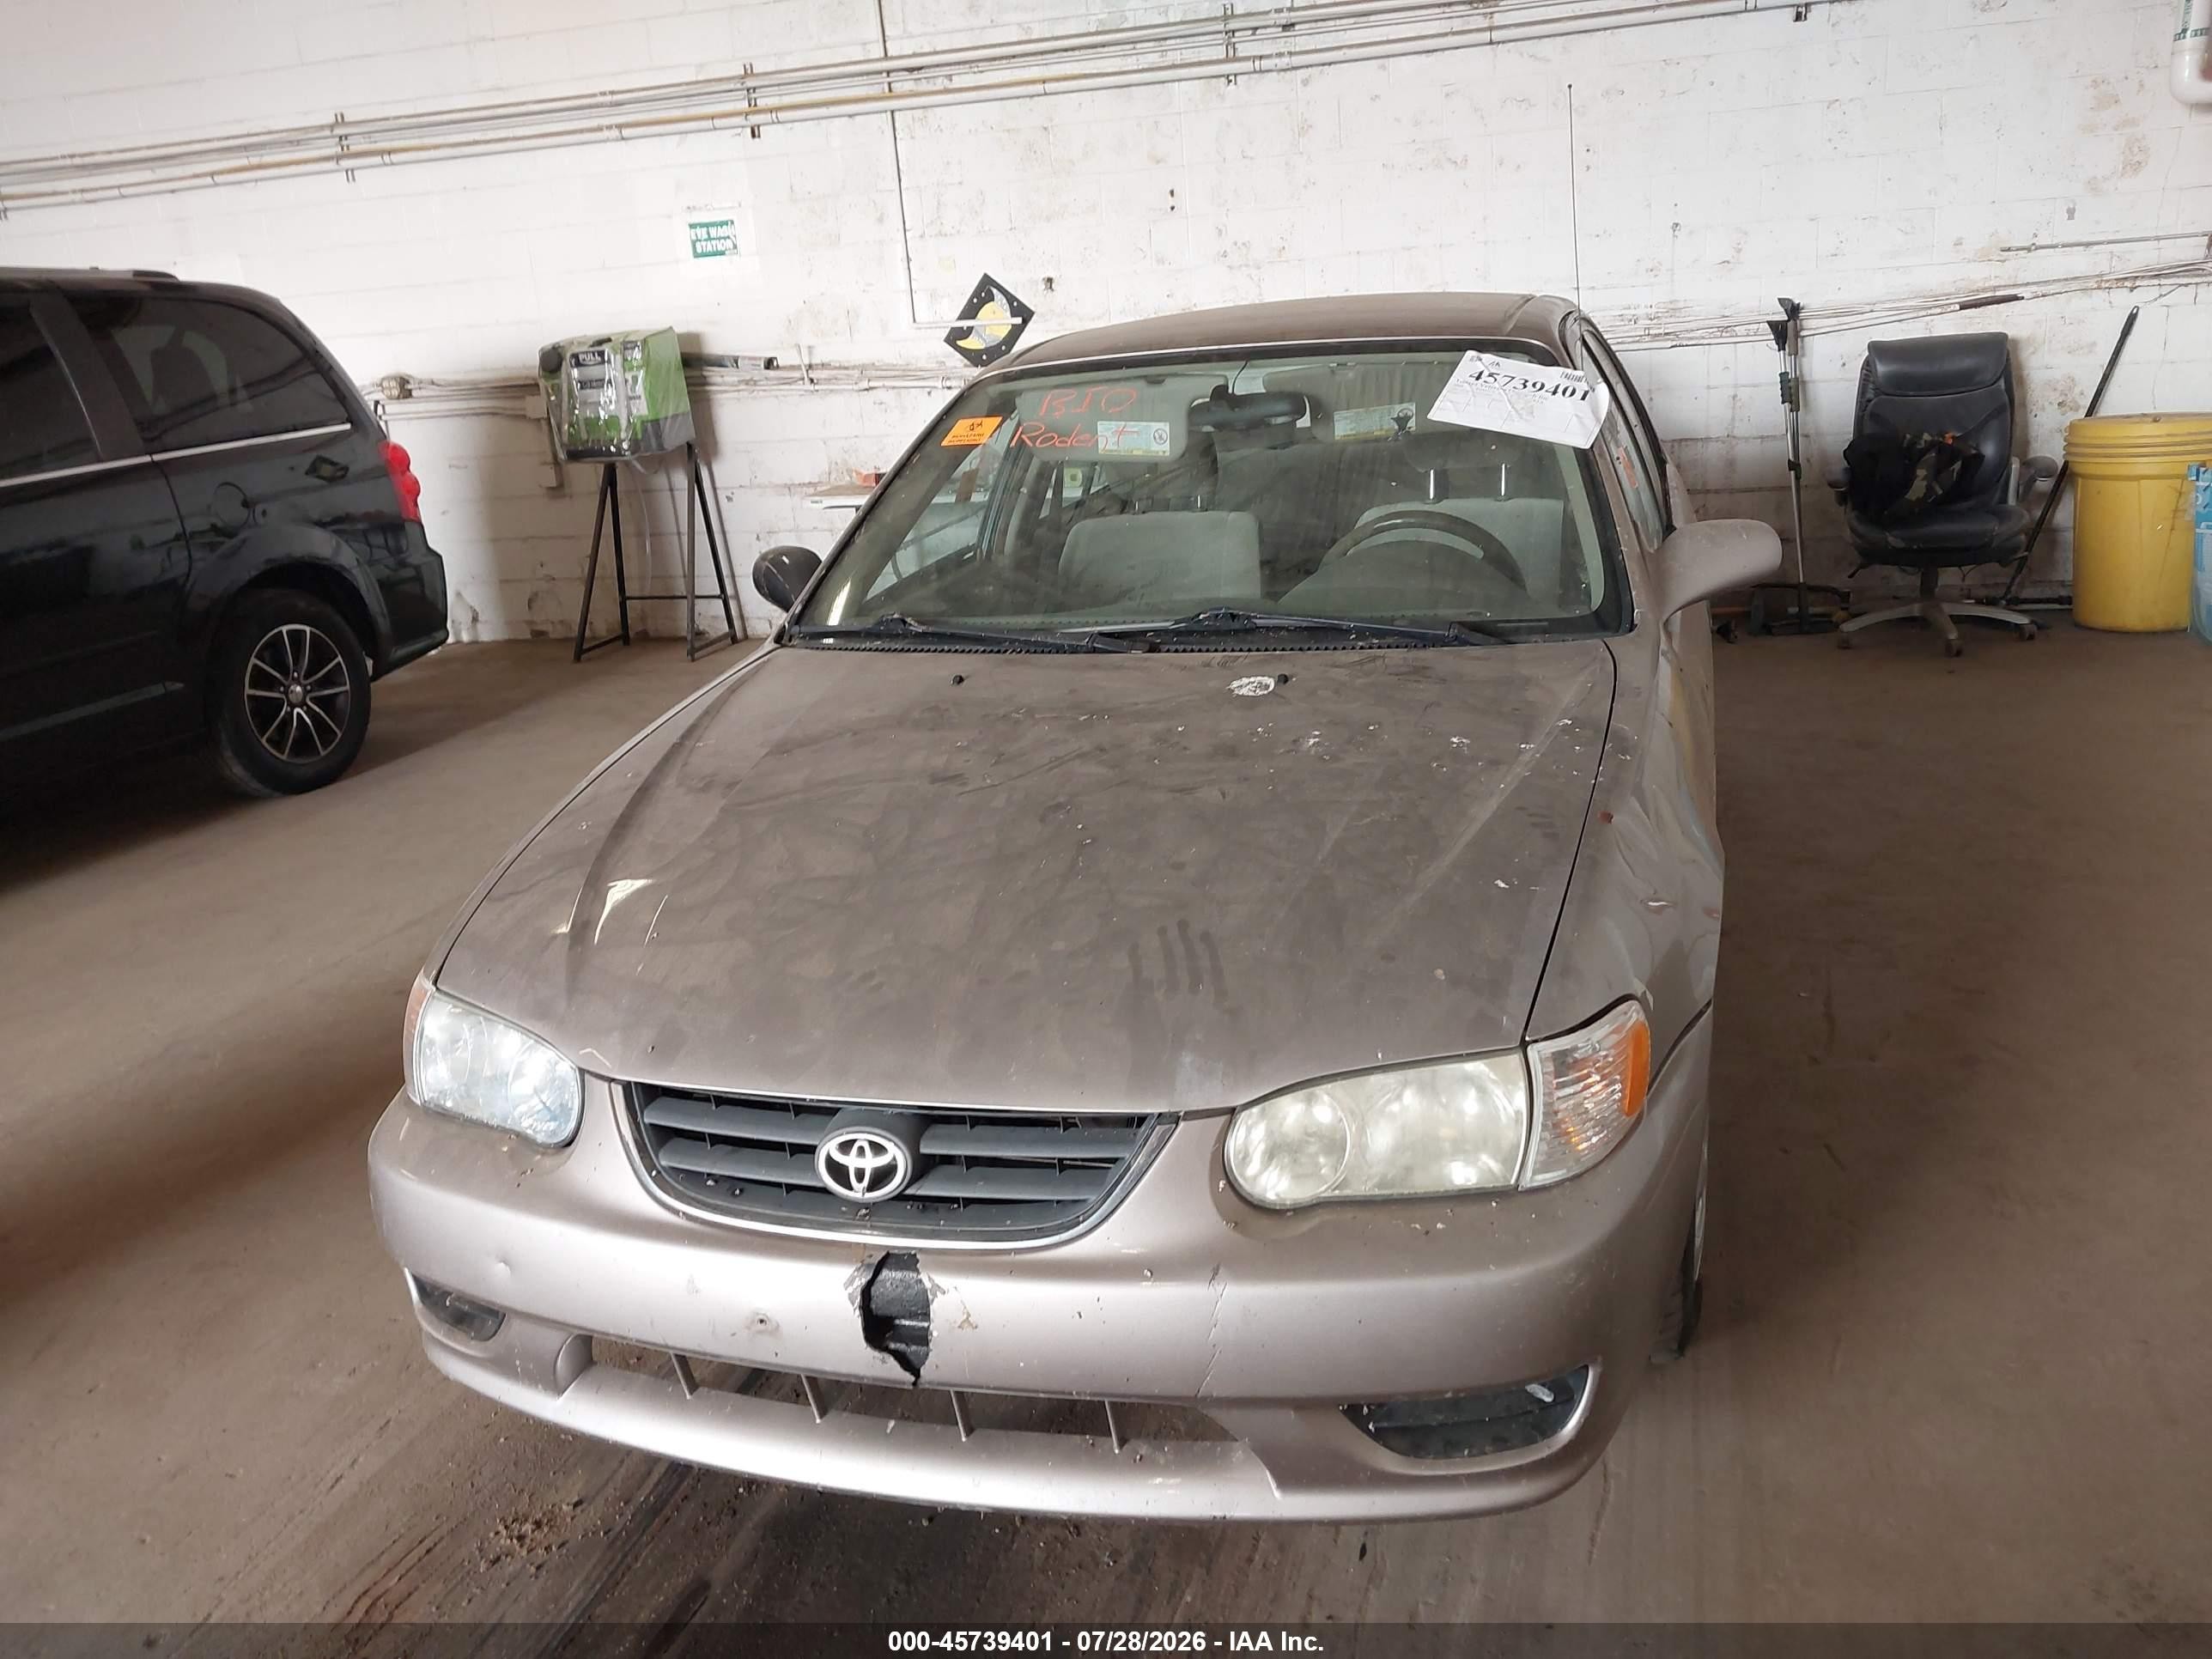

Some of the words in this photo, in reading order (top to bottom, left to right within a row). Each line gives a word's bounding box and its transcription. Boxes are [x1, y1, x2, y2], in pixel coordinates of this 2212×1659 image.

[690, 227, 708, 240] EYE
[696, 240, 733, 253] STATION
[1469, 369, 1590, 401] 45739401
[1011, 422, 1140, 453] Rodent
